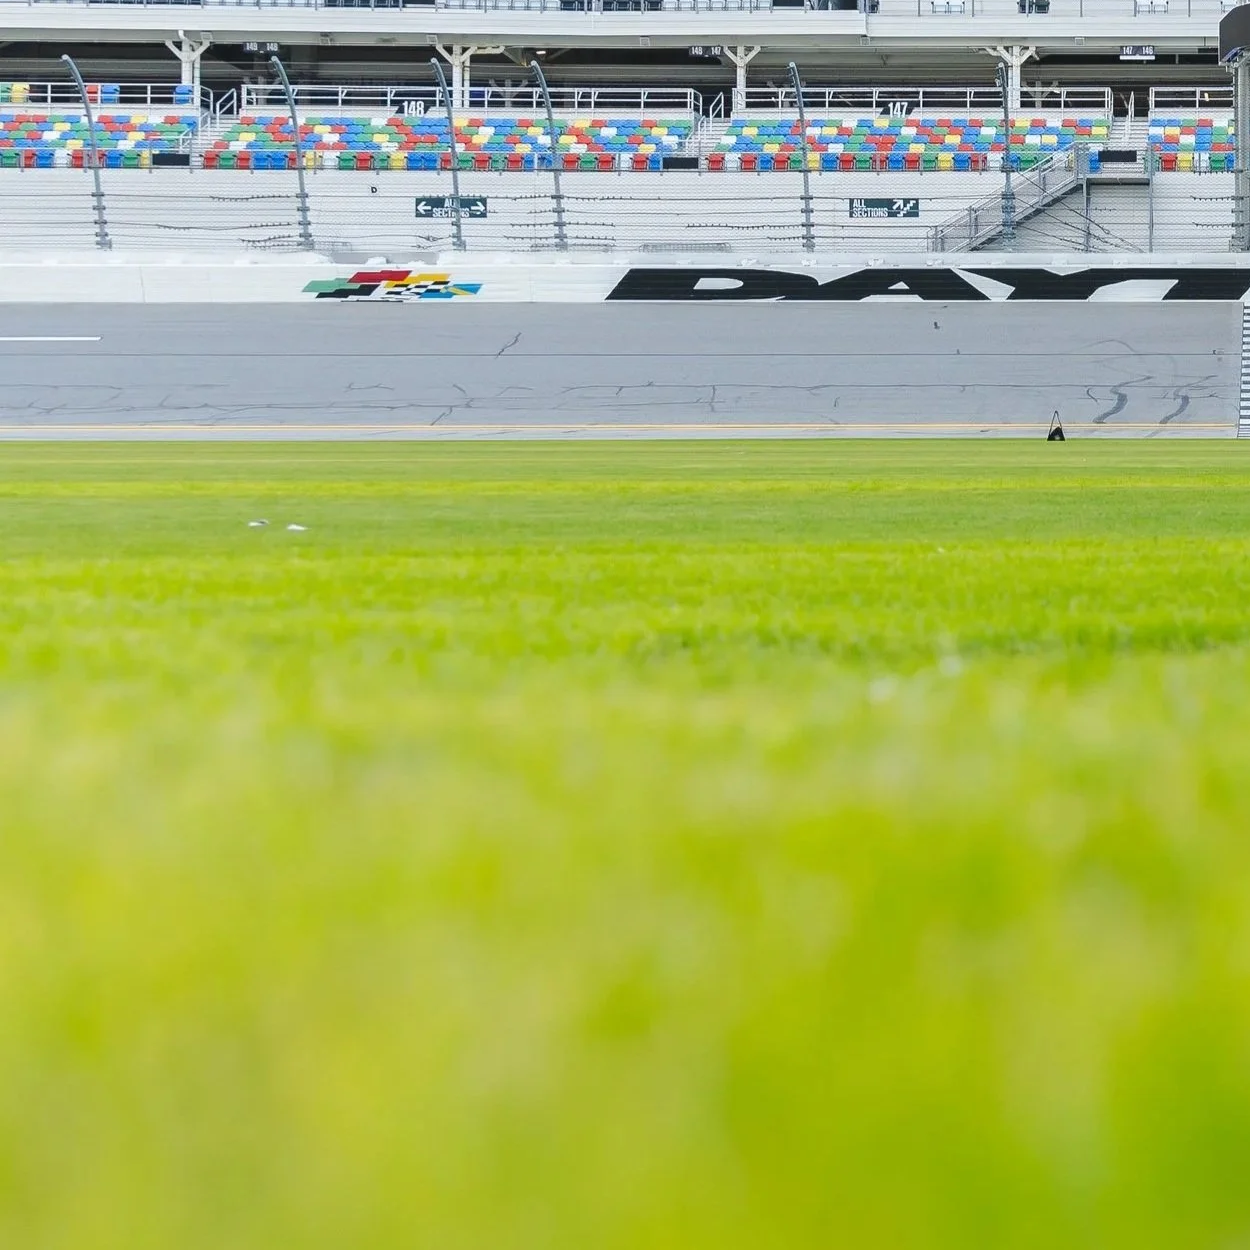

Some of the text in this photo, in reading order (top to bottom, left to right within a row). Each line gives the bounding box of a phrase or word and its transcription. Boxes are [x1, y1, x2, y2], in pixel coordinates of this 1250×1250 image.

[402, 100, 425, 117] 148
[888, 101, 908, 118] 147
[853, 198, 866, 208] ALL
[852, 207, 889, 218] SECTIONS
